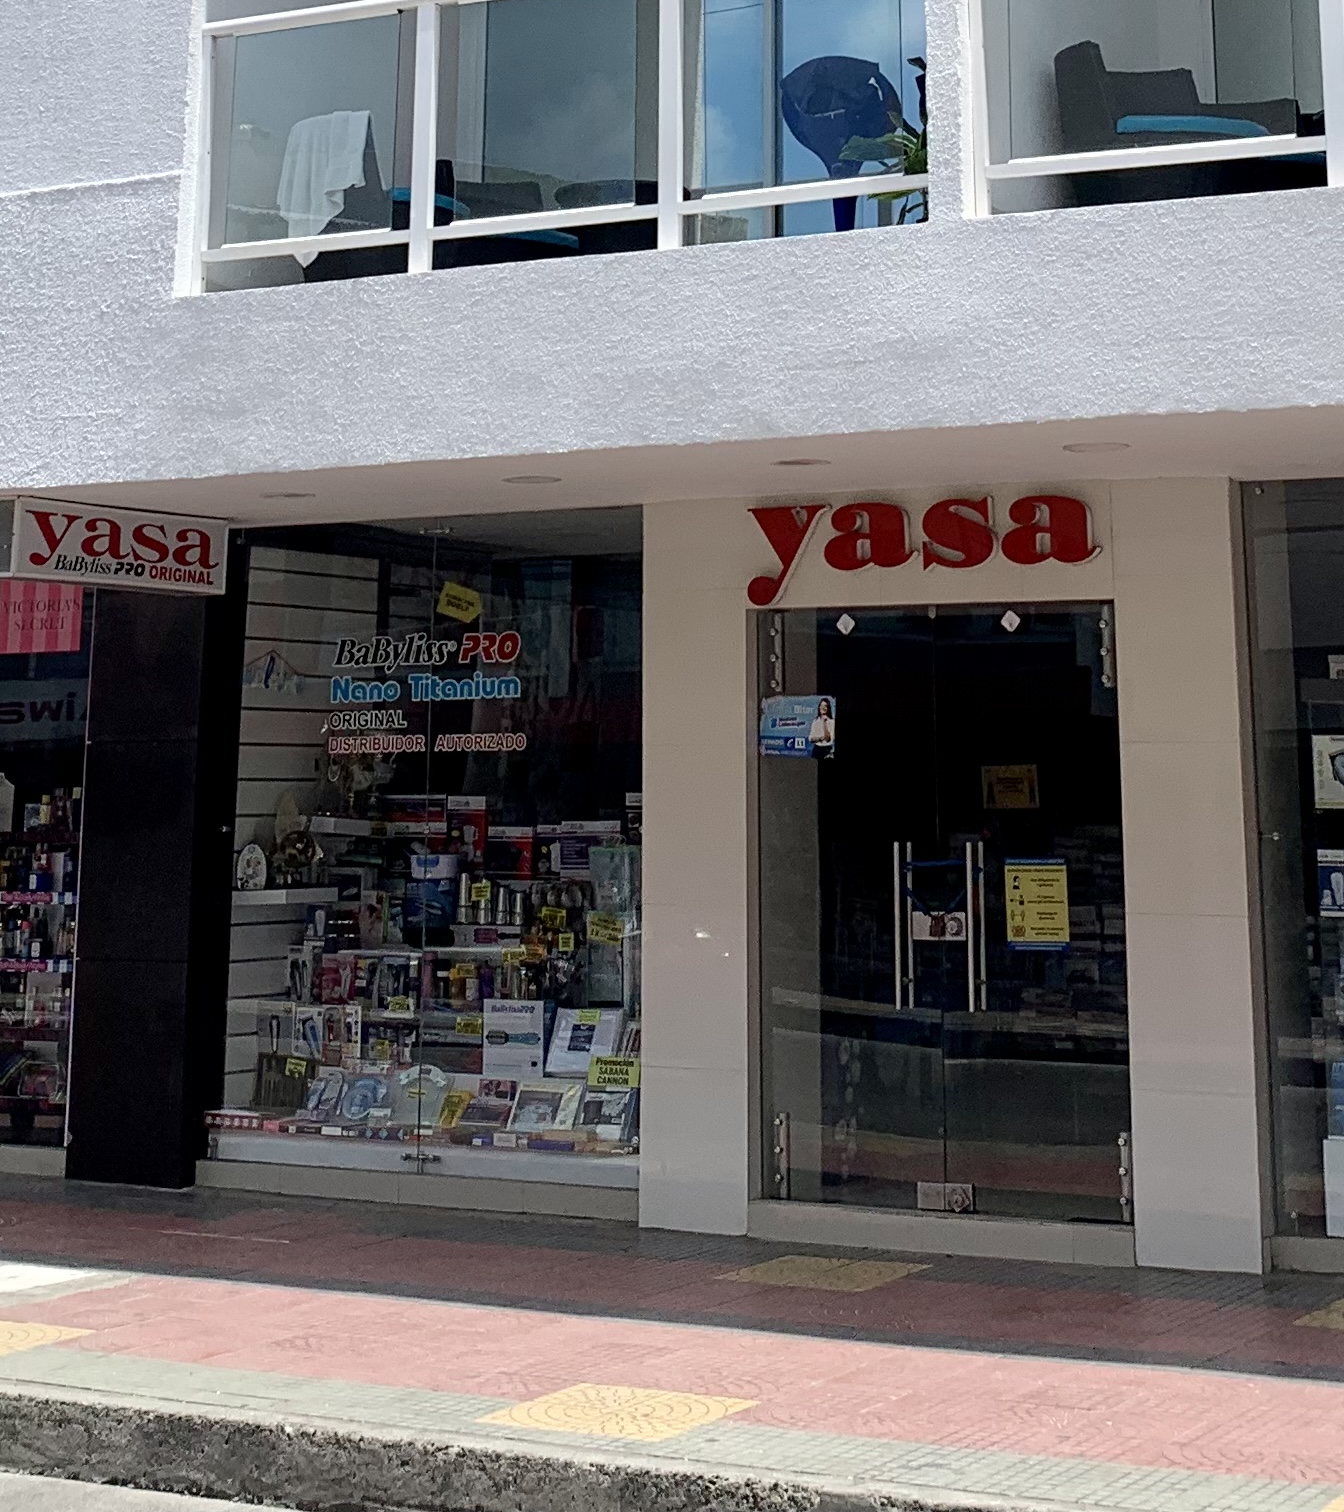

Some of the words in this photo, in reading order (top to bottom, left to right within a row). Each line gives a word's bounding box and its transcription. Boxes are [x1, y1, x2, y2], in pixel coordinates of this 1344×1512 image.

[25, 510, 219, 570] yasa
[746, 493, 1103, 606] yasa
[54, 554, 113, 576] BaByliss
[114, 561, 146, 577] PRO
[149, 565, 214, 585] ORIGINAL
[458, 631, 522, 664] PRO
[330, 675, 401, 704] Nano
[408, 670, 522, 702] Titanium
[329, 709, 408, 730] ORIGINAL
[328, 735, 426, 755] DISTRIBUIDOR
[433, 733, 527, 752] AUTORIZADO
